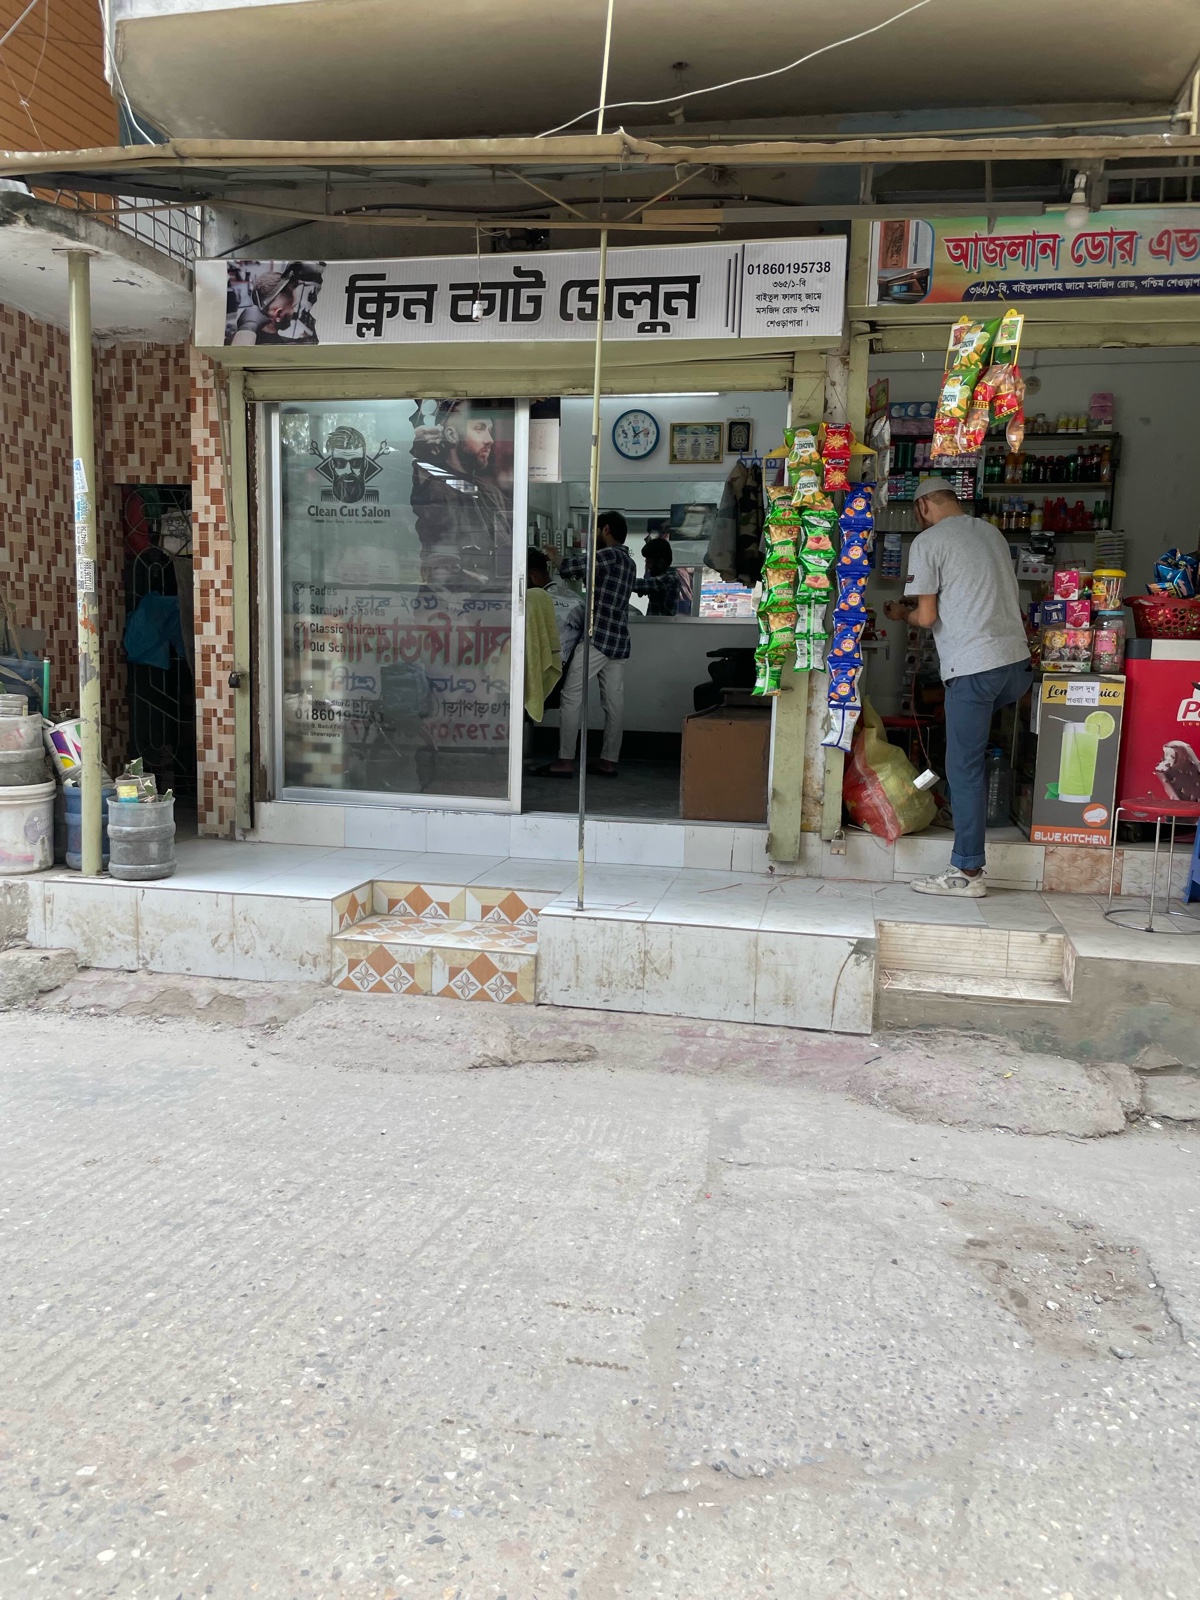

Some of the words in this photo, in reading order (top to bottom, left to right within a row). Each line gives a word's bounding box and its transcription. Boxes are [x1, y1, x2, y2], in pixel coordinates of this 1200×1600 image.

[943, 228, 1060, 272] আজলান
[1070, 225, 1138, 265] ডোর
[747, 261, 831, 275] 01860195738
[1087, 278, 1114, 290] মসজিদ
[1117, 279, 1138, 291] রোড,
[1140, 277, 1164, 289] পশ্চিম
[344, 273, 438, 338] ক্লিন
[448, 265, 546, 323] কাট
[560, 274, 701, 334] সেলুন
[755, 292, 779, 303] বাইতুল
[804, 292, 822, 301] জামে
[755, 305, 780, 314] মসজিদ
[782, 306, 798, 314] রোড
[800, 304, 820, 314] পশ্চিম
[307, 505, 337, 517] Clean
[339, 506, 359, 517] Cut
[361, 506, 391, 518] Salon
[309, 585, 338, 596] Fades
[309, 604, 348, 618] Straight
[351, 605, 386, 617] Shaves
[309, 622, 344, 635] Classic
[309, 641, 325, 653] Old
[1099, 688, 1121, 698] uice
[1033, 831, 1062, 842] BLUE
[1063, 833, 1107, 845] KITCHEN
